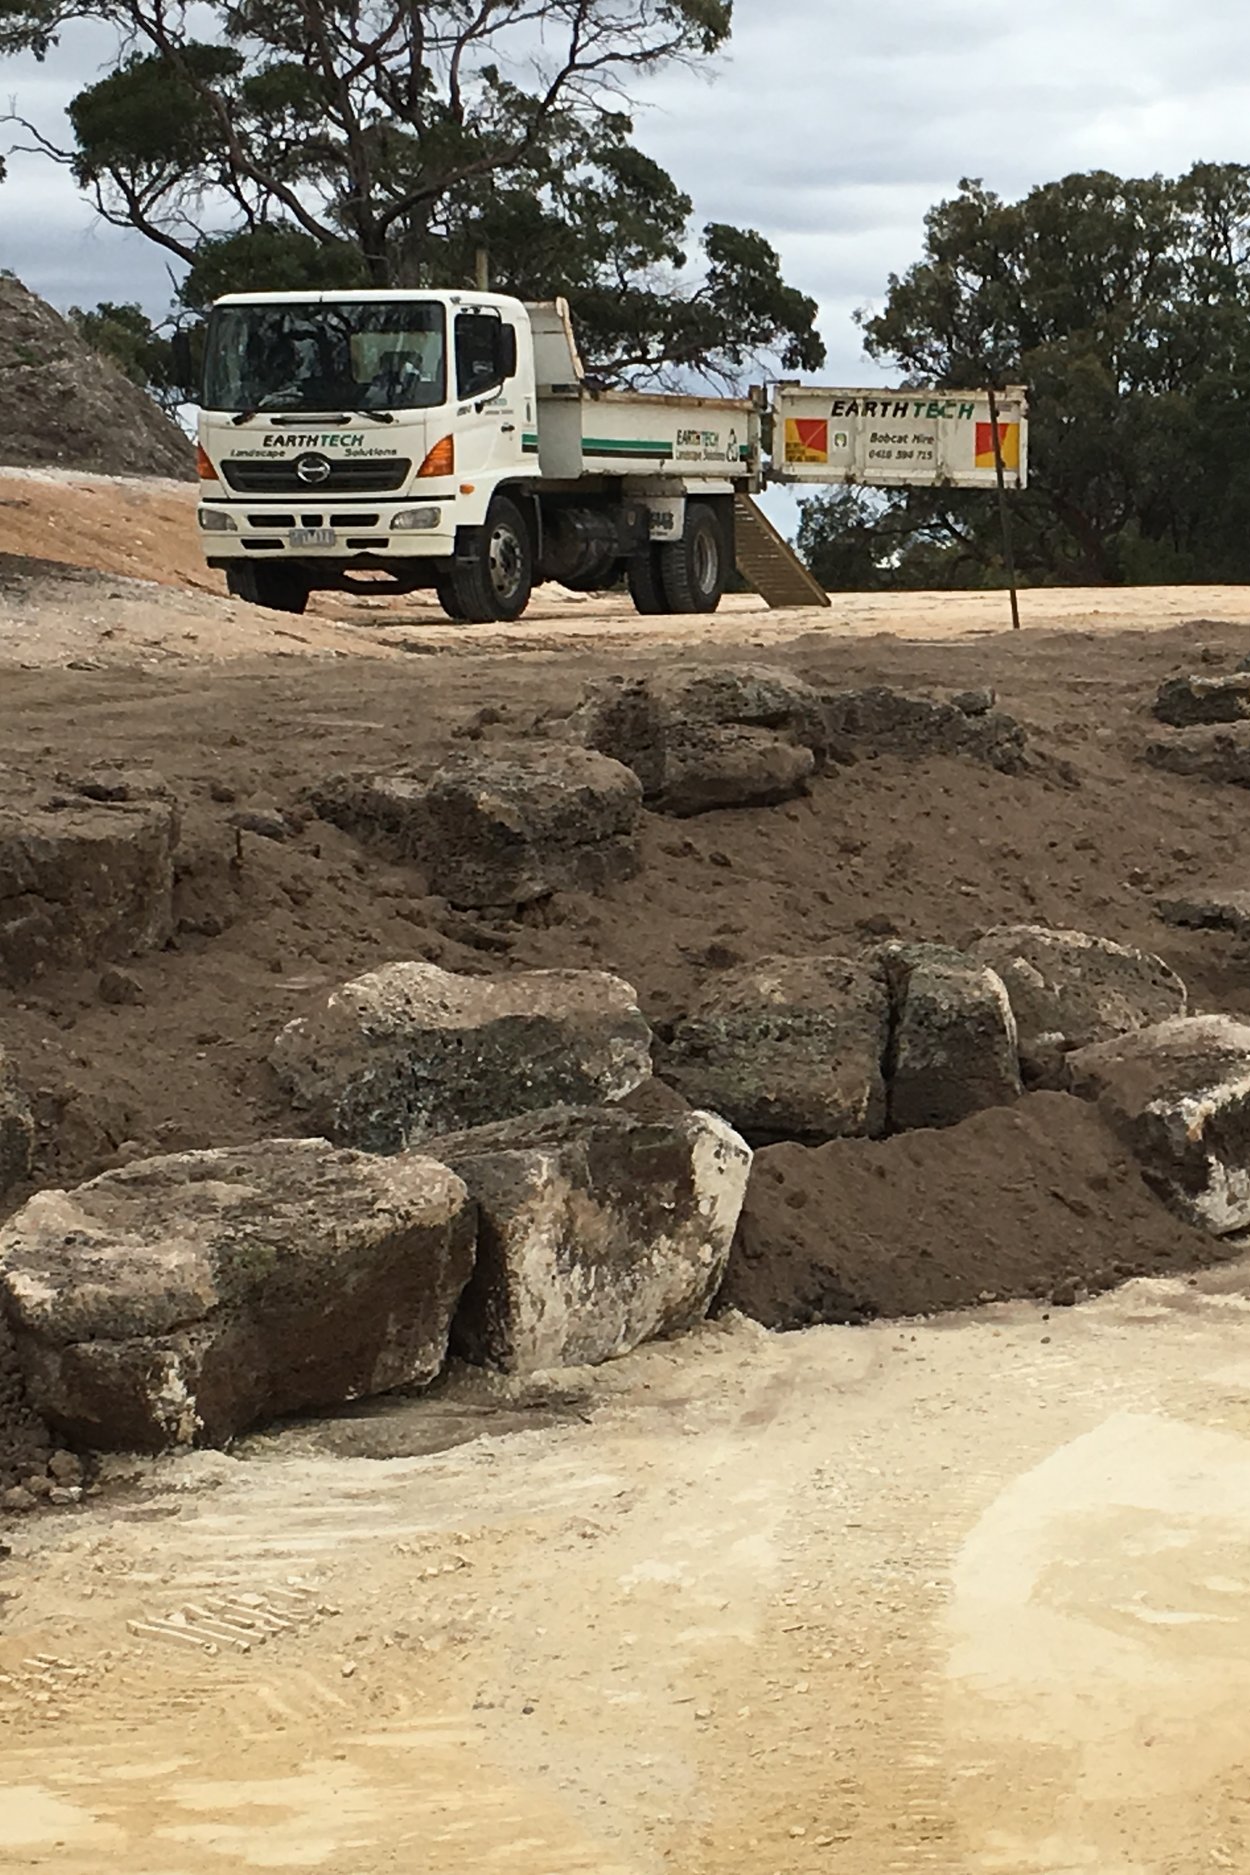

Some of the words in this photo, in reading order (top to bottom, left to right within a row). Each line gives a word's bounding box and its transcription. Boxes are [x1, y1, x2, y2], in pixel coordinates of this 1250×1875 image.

[262, 434, 365, 447] EARTHTECH
[870, 432, 908, 444] Bobcat
[911, 433, 935, 445] Hire
[230, 448, 286, 458] Landscape
[344, 447, 397, 457] Solutions
